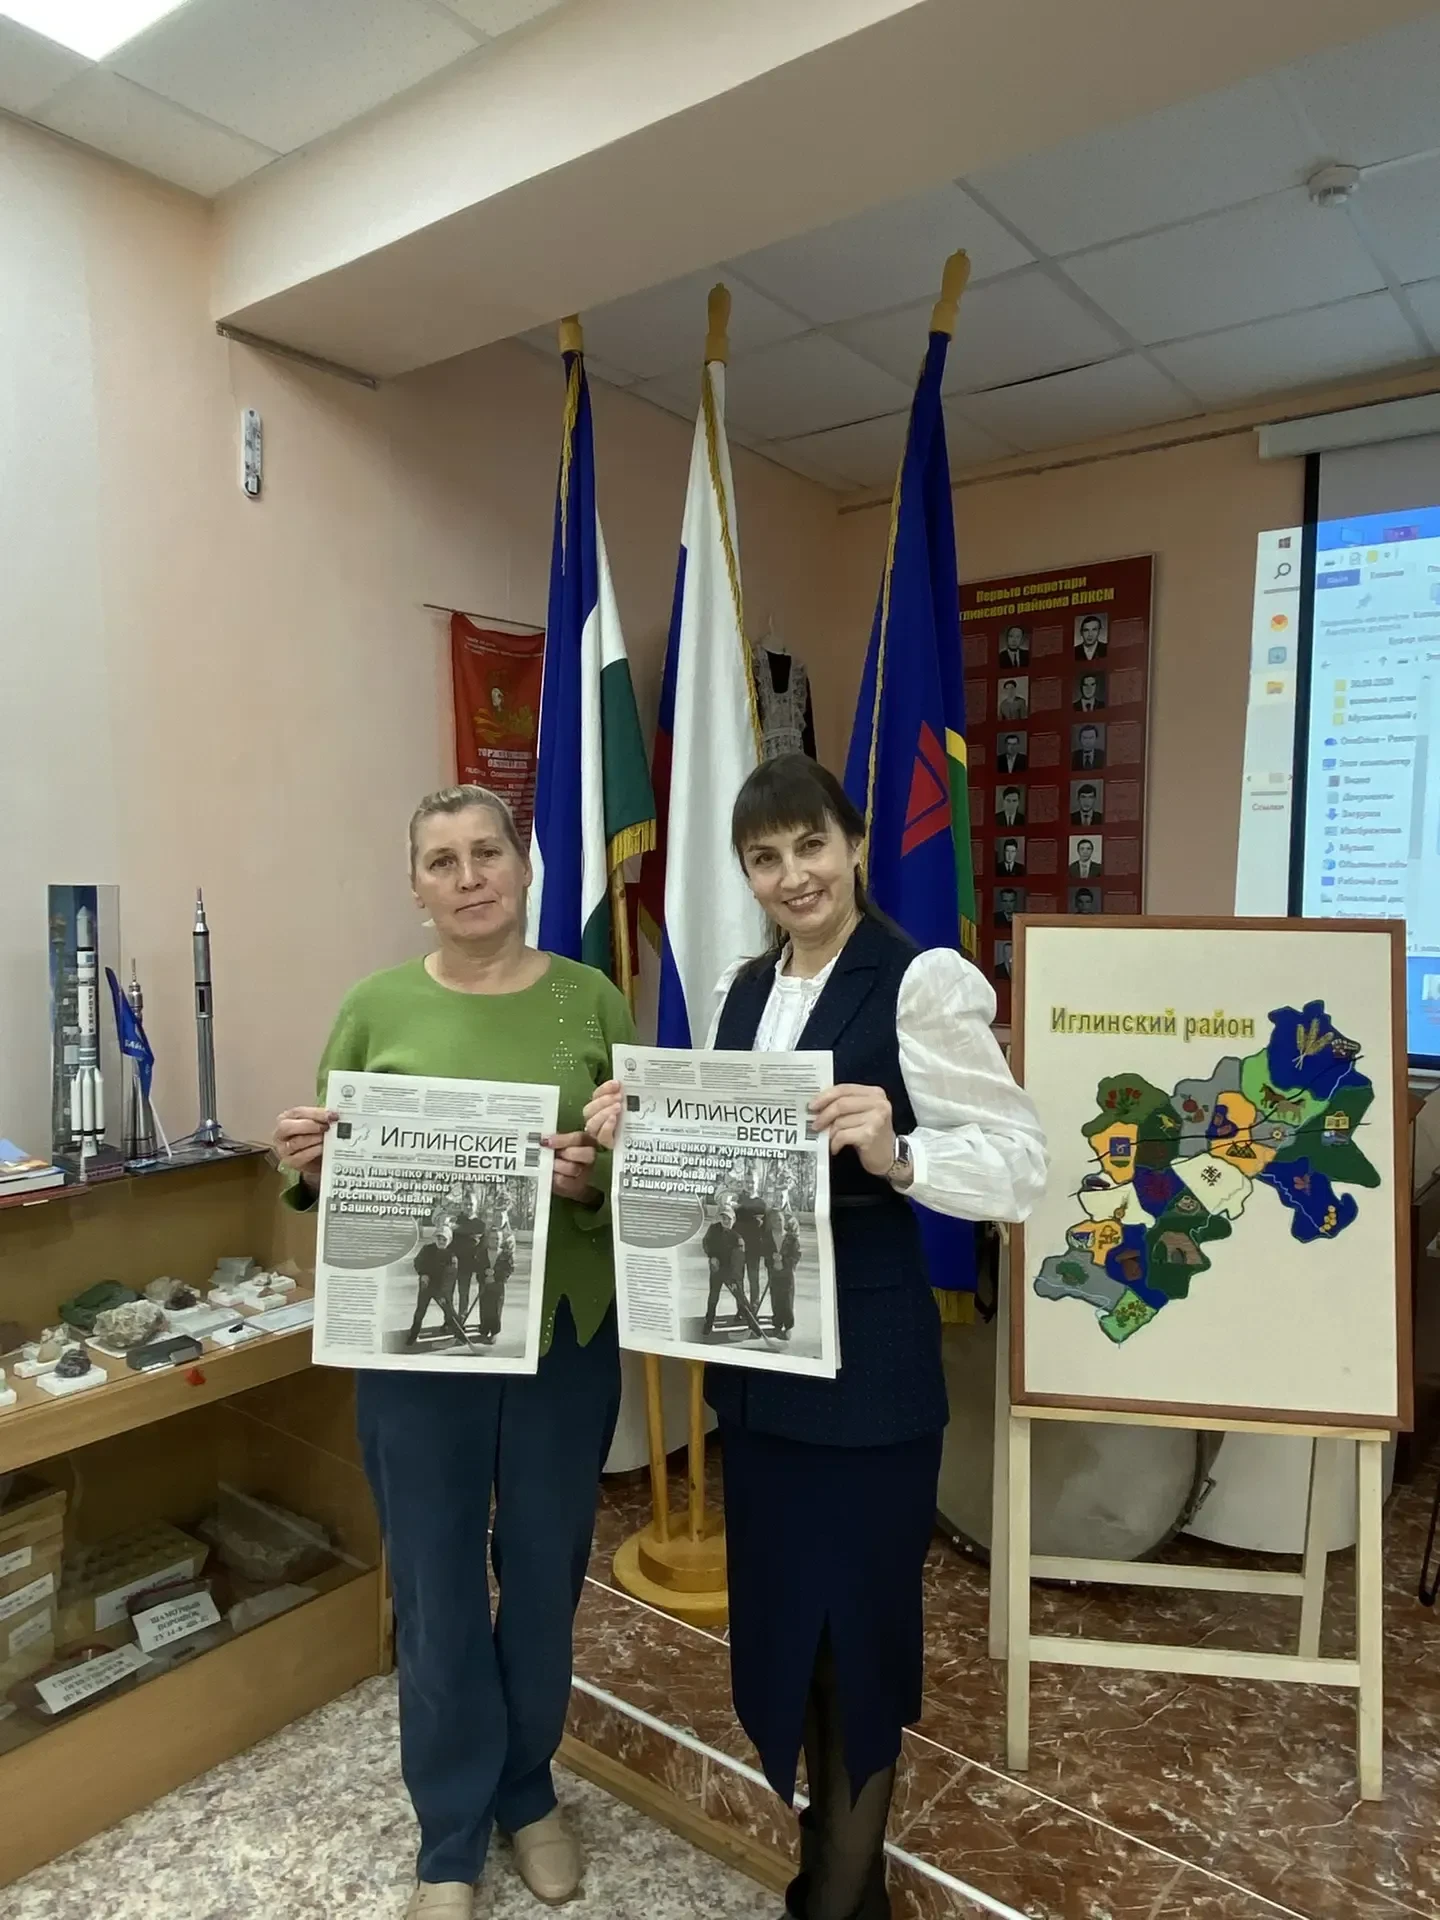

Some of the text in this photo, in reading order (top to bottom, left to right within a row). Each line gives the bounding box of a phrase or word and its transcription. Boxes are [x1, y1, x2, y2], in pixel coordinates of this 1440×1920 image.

[976, 576, 1087, 603] Первые секретари
[959, 588, 1114, 621] глинского райкома ВЛКСМ
[1051, 1006, 1255, 1043] Иглинский район
[737, 1127, 798, 1145] ВЕСТИ
[624, 1136, 787, 1159] Фонд Тимченко и журналисты
[454, 1155, 517, 1171] ВЕСТИ
[624, 1153, 733, 1169] из разных регионов
[333, 1164, 506, 1184] Фонд Тимченко и журналисты
[624, 1164, 718, 1181] России побывали
[332, 1179, 450, 1194] из разных регионов
[623, 1176, 715, 1194] в Башкортостане
[332, 1189, 433, 1204] России побывали
[329, 1202, 432, 1217] в Башкортостане
